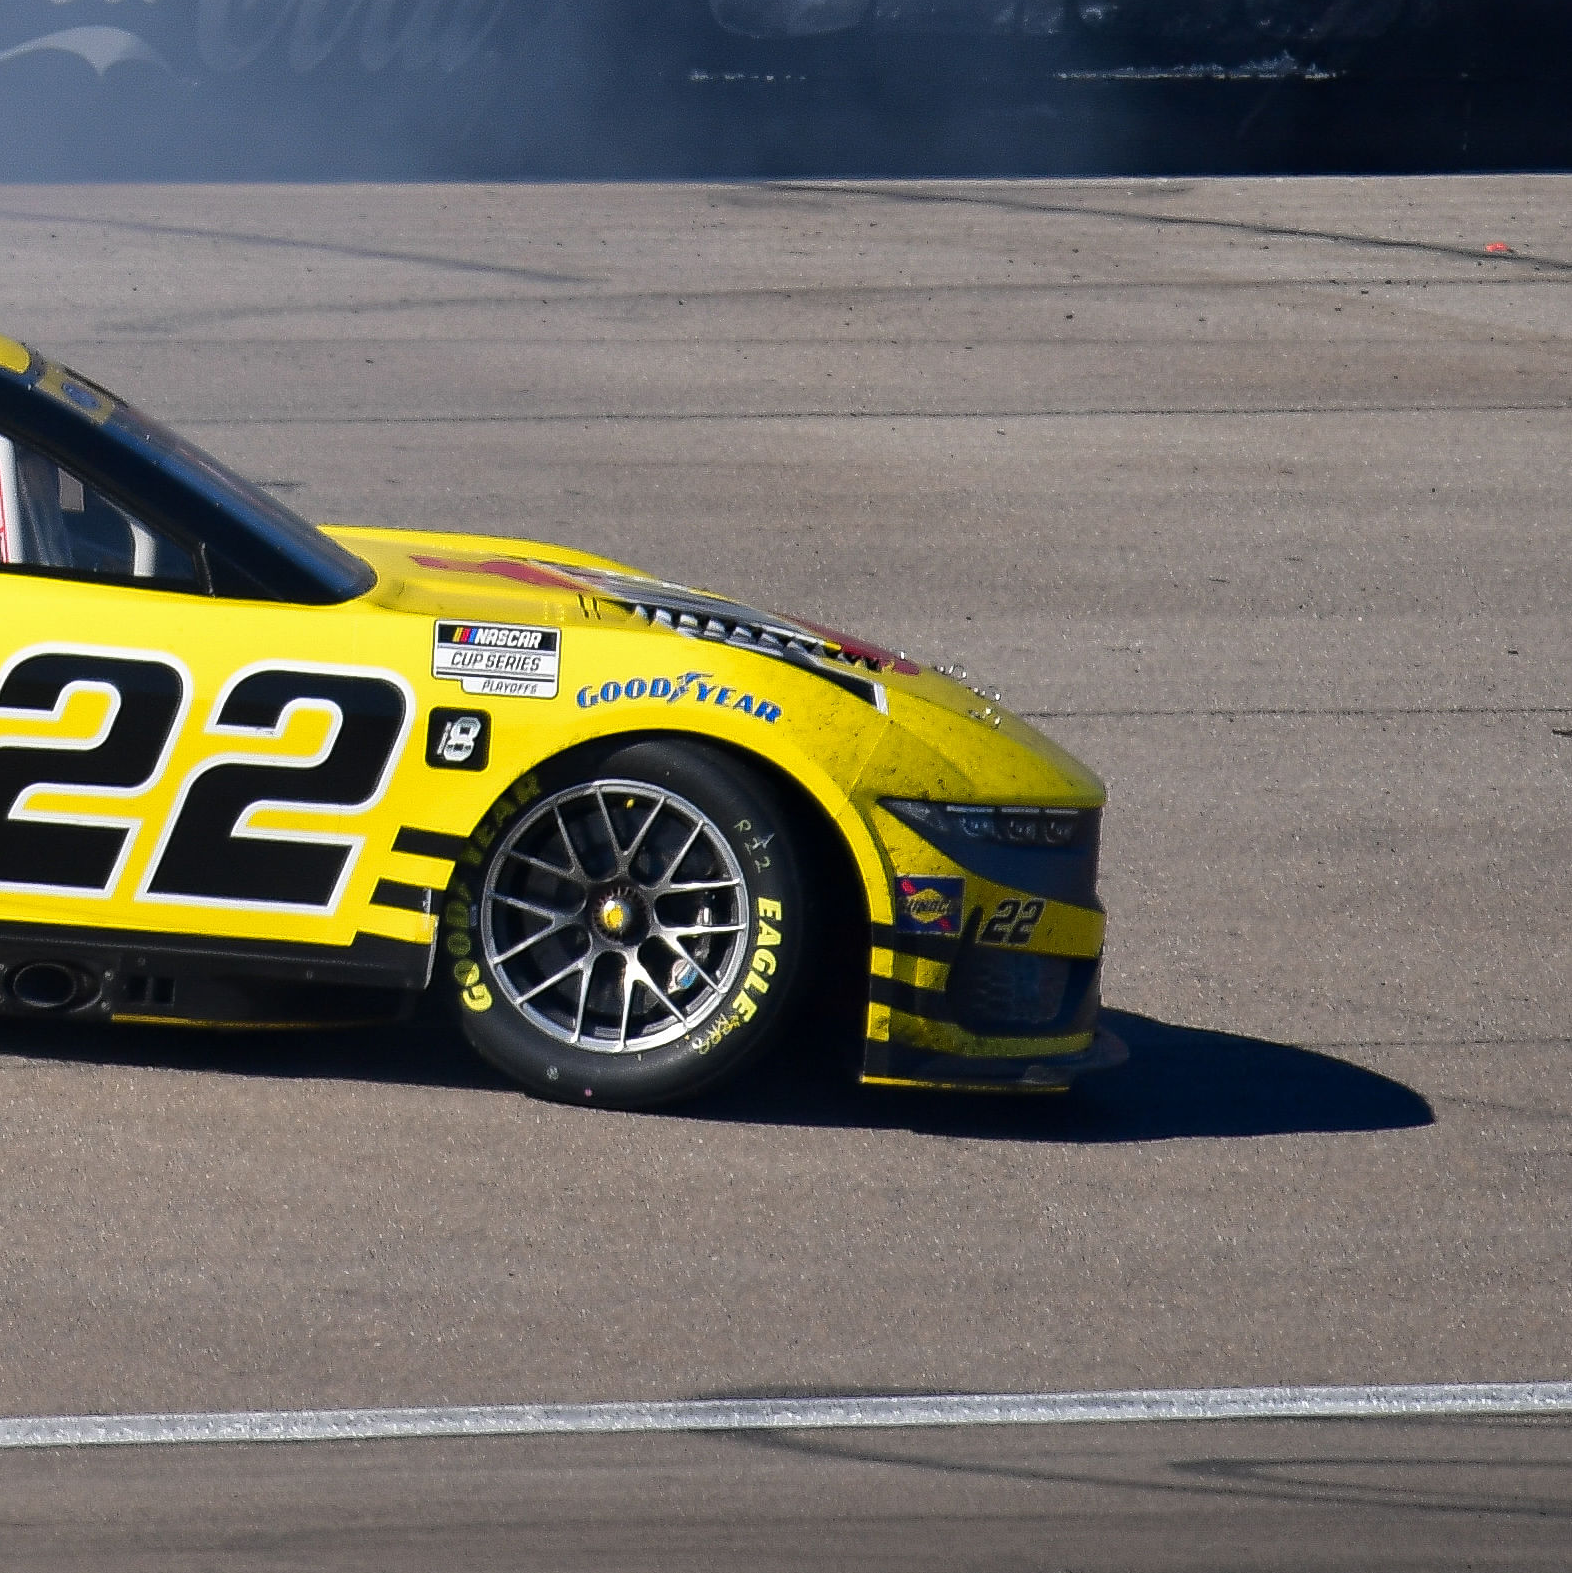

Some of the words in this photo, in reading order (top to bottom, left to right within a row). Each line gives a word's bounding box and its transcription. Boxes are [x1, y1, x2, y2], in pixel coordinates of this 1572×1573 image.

[472, 627, 543, 650] NASCAR
[450, 650, 483, 670] CUP
[485, 651, 543, 673] SERIES
[481, 679, 538, 695] PLAYOFFS
[975, 897, 1048, 948] 22
[731, 896, 784, 1024] EAGLE
